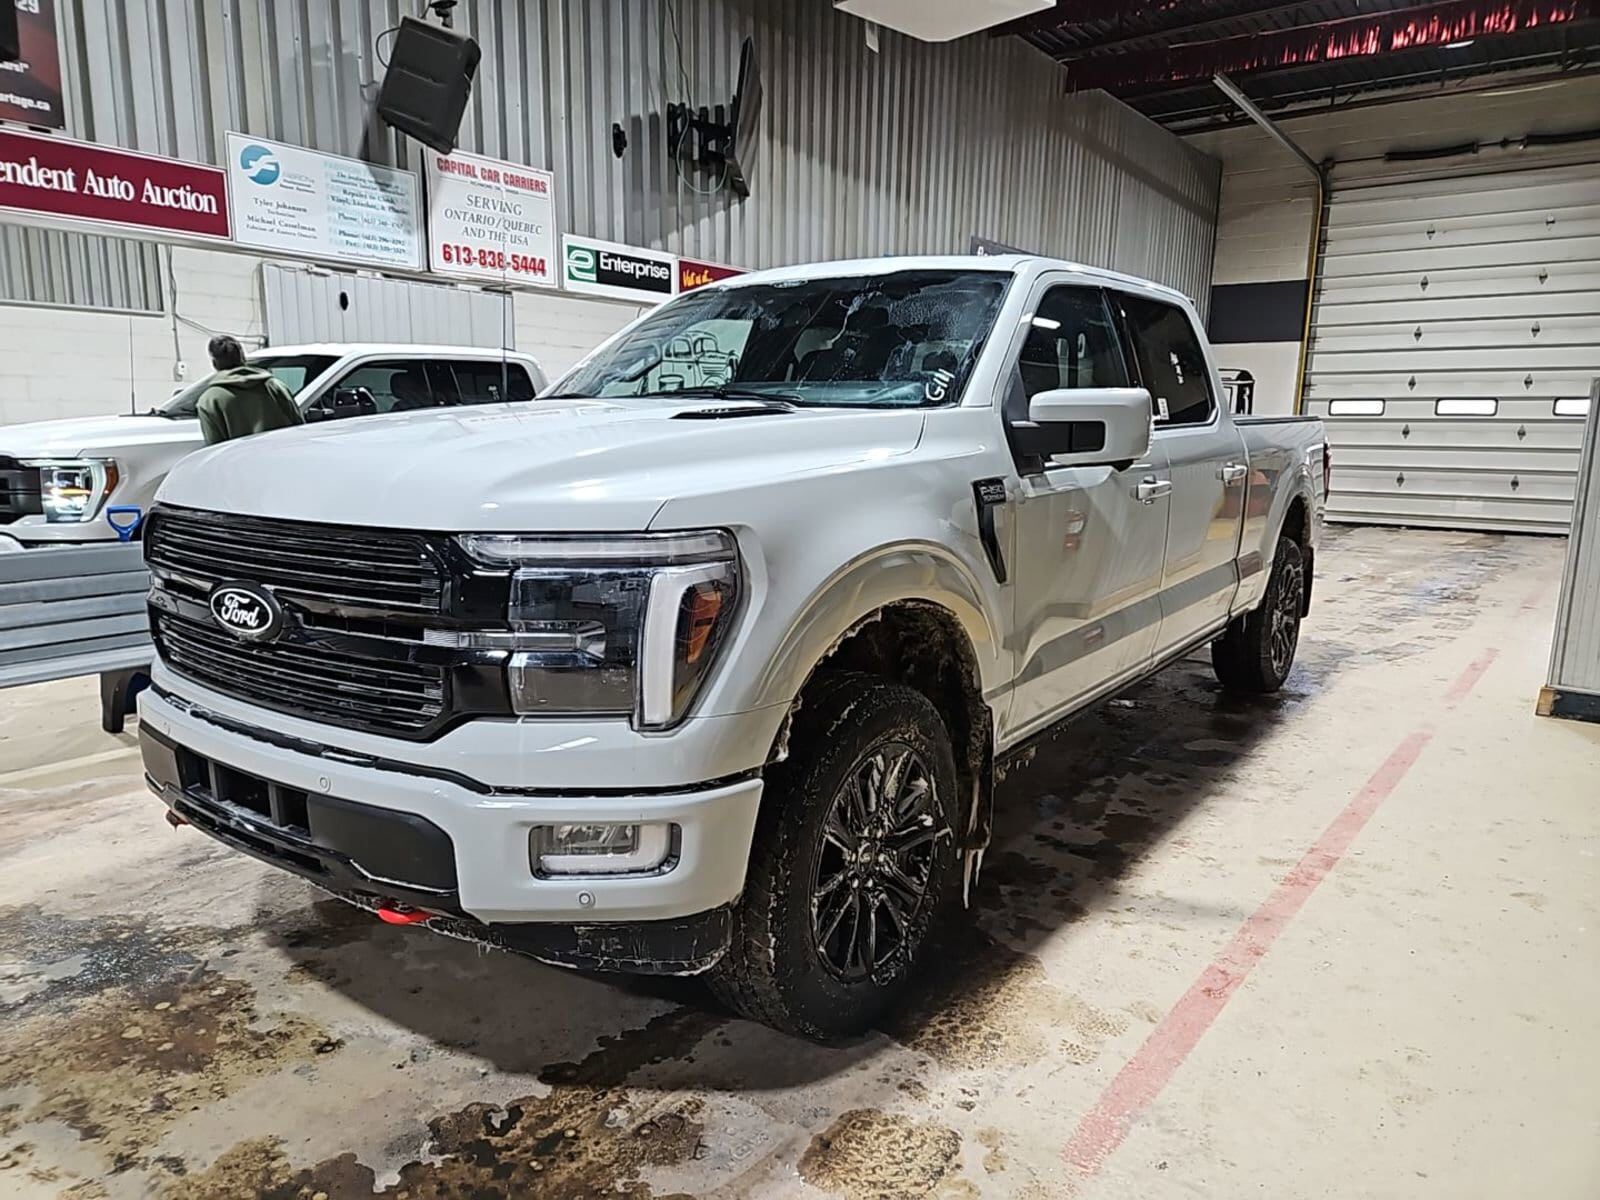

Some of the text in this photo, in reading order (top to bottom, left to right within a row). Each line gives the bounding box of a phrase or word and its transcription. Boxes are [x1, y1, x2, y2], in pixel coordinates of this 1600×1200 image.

[83, 168, 135, 201] Auto
[141, 178, 218, 215] Auction
[437, 158, 478, 179] CAPITAL
[480, 168, 500, 183] CAR
[503, 172, 548, 194] CARRIERS
[247, 214, 276, 226] Michael
[466, 194, 522, 216] SERVING
[462, 226, 529, 246] AND THE USA
[442, 243, 547, 277] 613-838-5444
[600, 252, 670, 280] Enterprise
[221, 592, 260, 627] Ford
